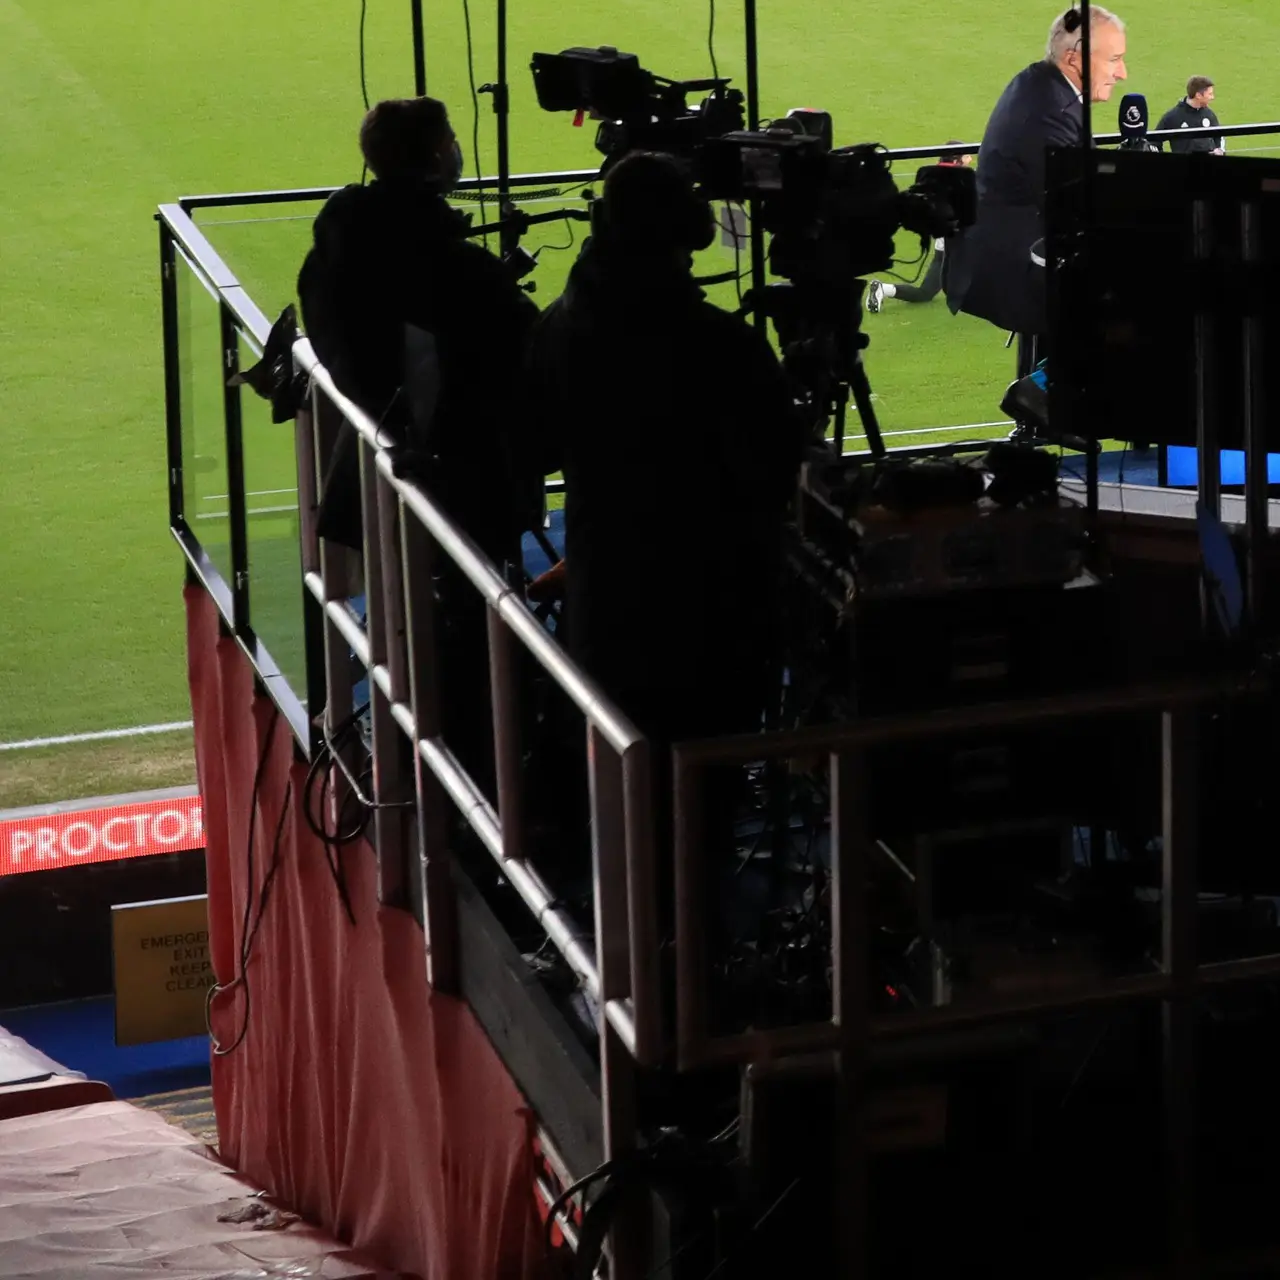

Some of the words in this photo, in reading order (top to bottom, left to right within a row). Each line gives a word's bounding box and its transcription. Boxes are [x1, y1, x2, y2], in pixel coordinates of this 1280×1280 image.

[141, 930, 208, 950] EMERGE
[174, 946, 206, 961] EXIT
[170, 961, 211, 977] KEEP
